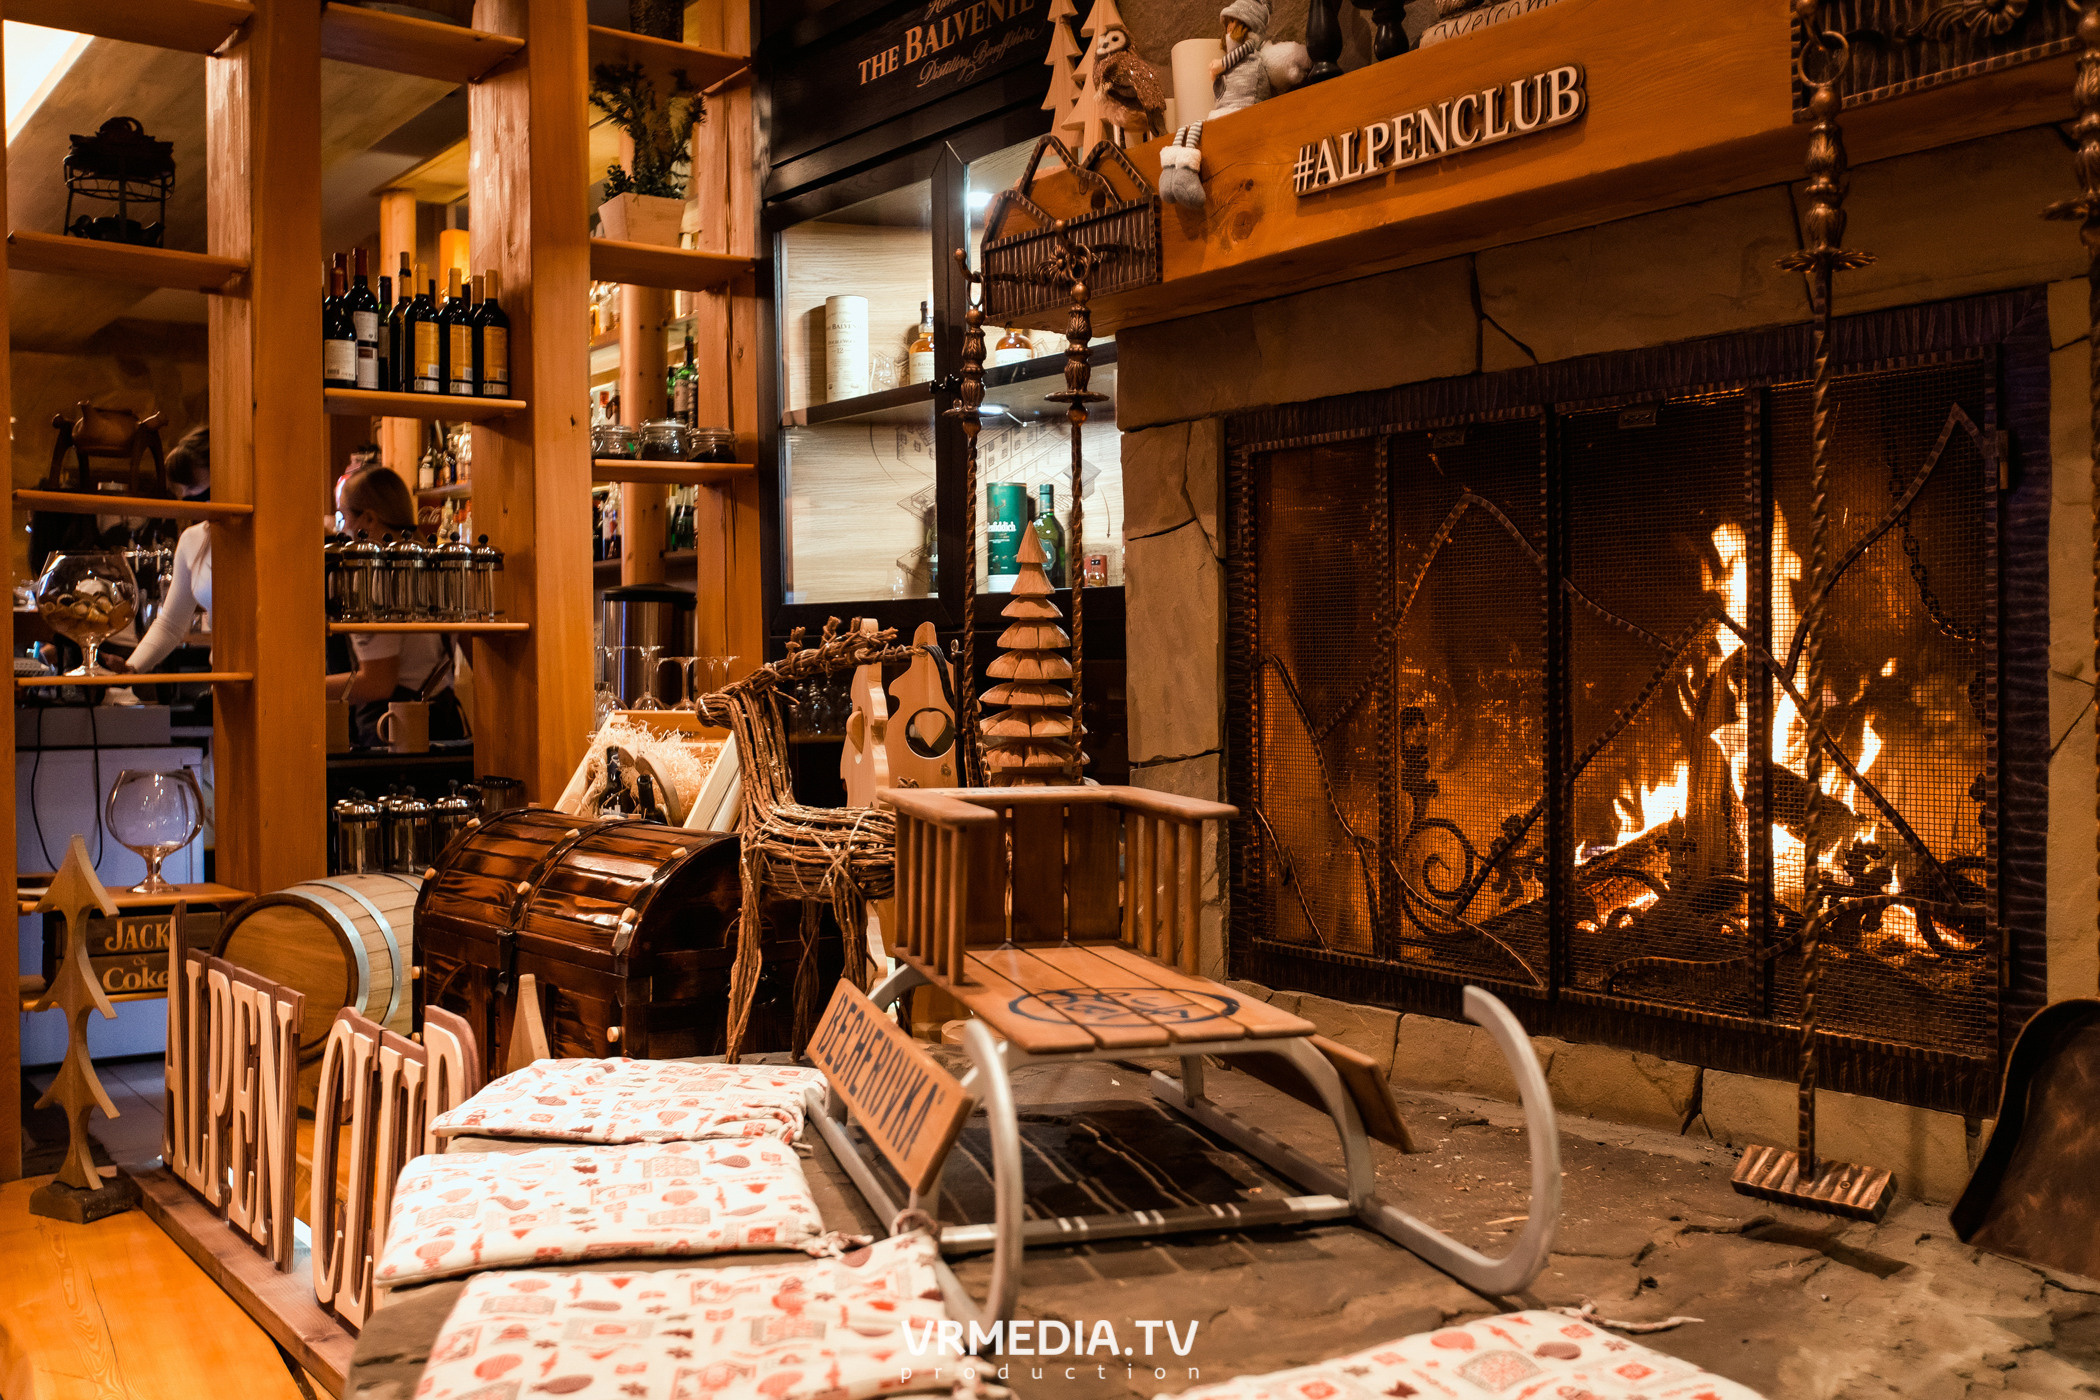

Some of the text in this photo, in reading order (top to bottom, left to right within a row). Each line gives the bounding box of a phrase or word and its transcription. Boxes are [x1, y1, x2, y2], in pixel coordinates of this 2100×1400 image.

[858, 45, 900, 86] THE
[1293, 65, 1582, 193] #ALPENCLUB
[104, 918, 170, 951] JACK
[102, 966, 169, 992] Coke
[163, 914, 295, 1264] ALPEN
[817, 992, 940, 1162] BECHEROVKA
